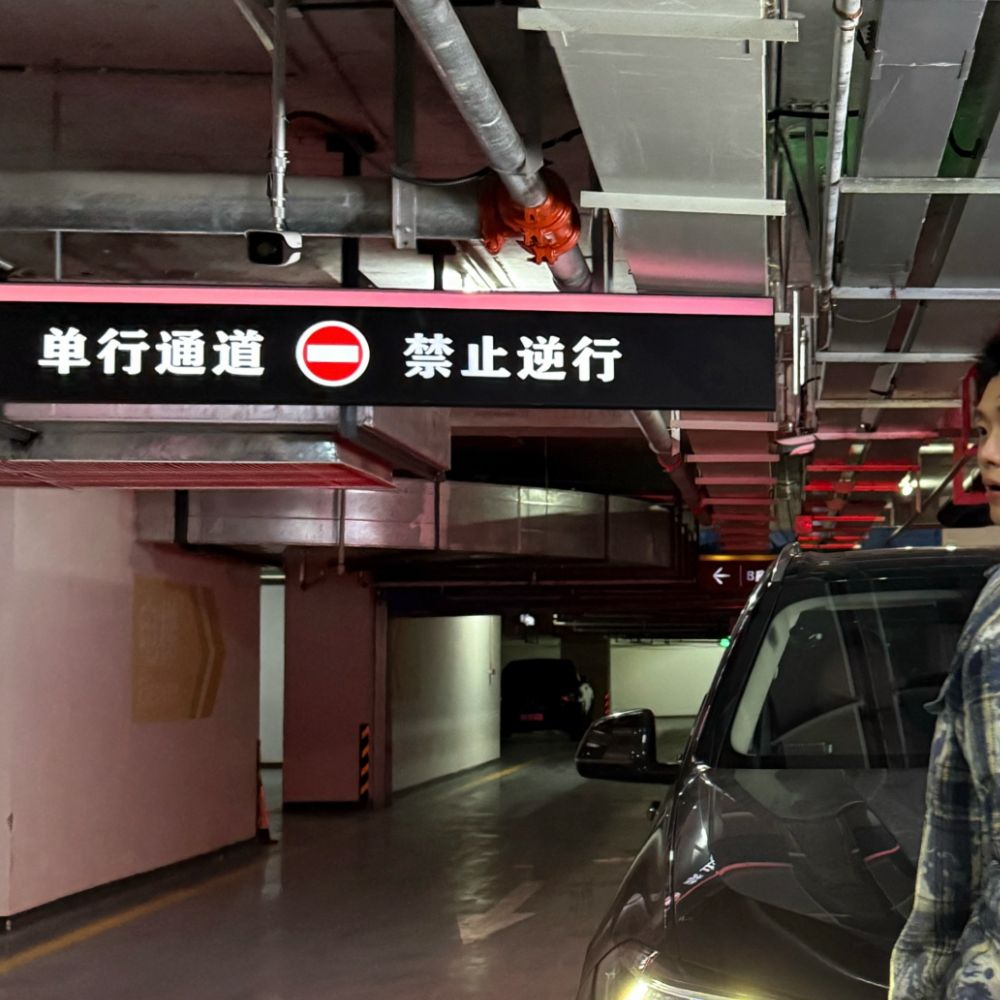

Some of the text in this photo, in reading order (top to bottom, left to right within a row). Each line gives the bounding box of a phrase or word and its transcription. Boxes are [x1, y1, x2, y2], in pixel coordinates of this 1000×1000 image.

[38, 326, 623, 382] 单行通道 禁止逆行
